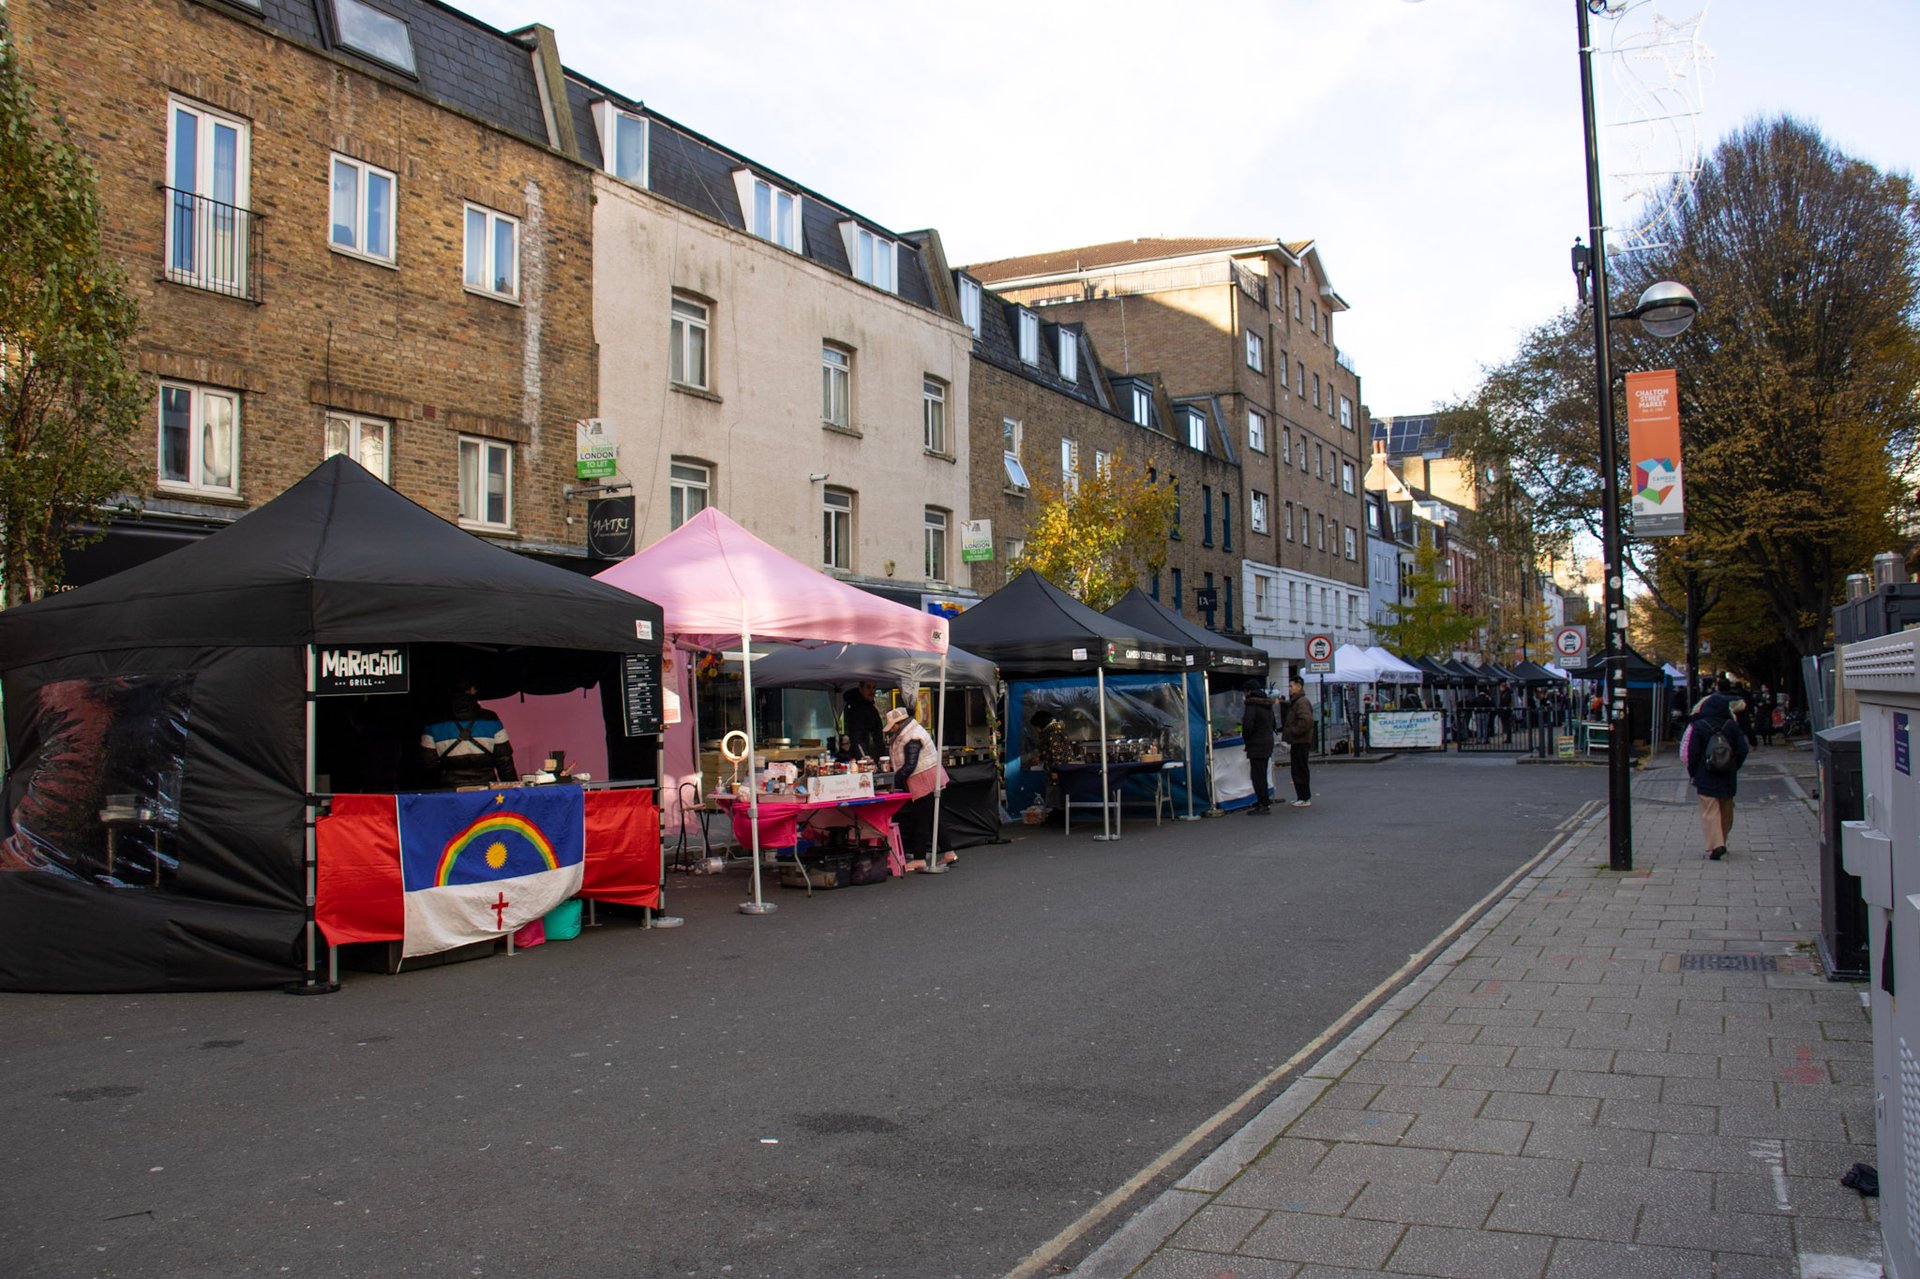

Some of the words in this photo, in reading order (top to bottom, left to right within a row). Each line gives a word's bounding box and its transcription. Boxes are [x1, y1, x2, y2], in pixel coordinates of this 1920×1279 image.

[1635, 388, 1669, 397] CHALTON
[1638, 400, 1667, 409] MARKET
[580, 451, 614, 460] LONDON
[596, 460, 608, 468] LET
[593, 517, 630, 538] YATRI
[1125, 649, 1141, 660] CAMDEN
[1140, 650, 1152, 661] STREET
[349, 678, 373, 687] GRILL
